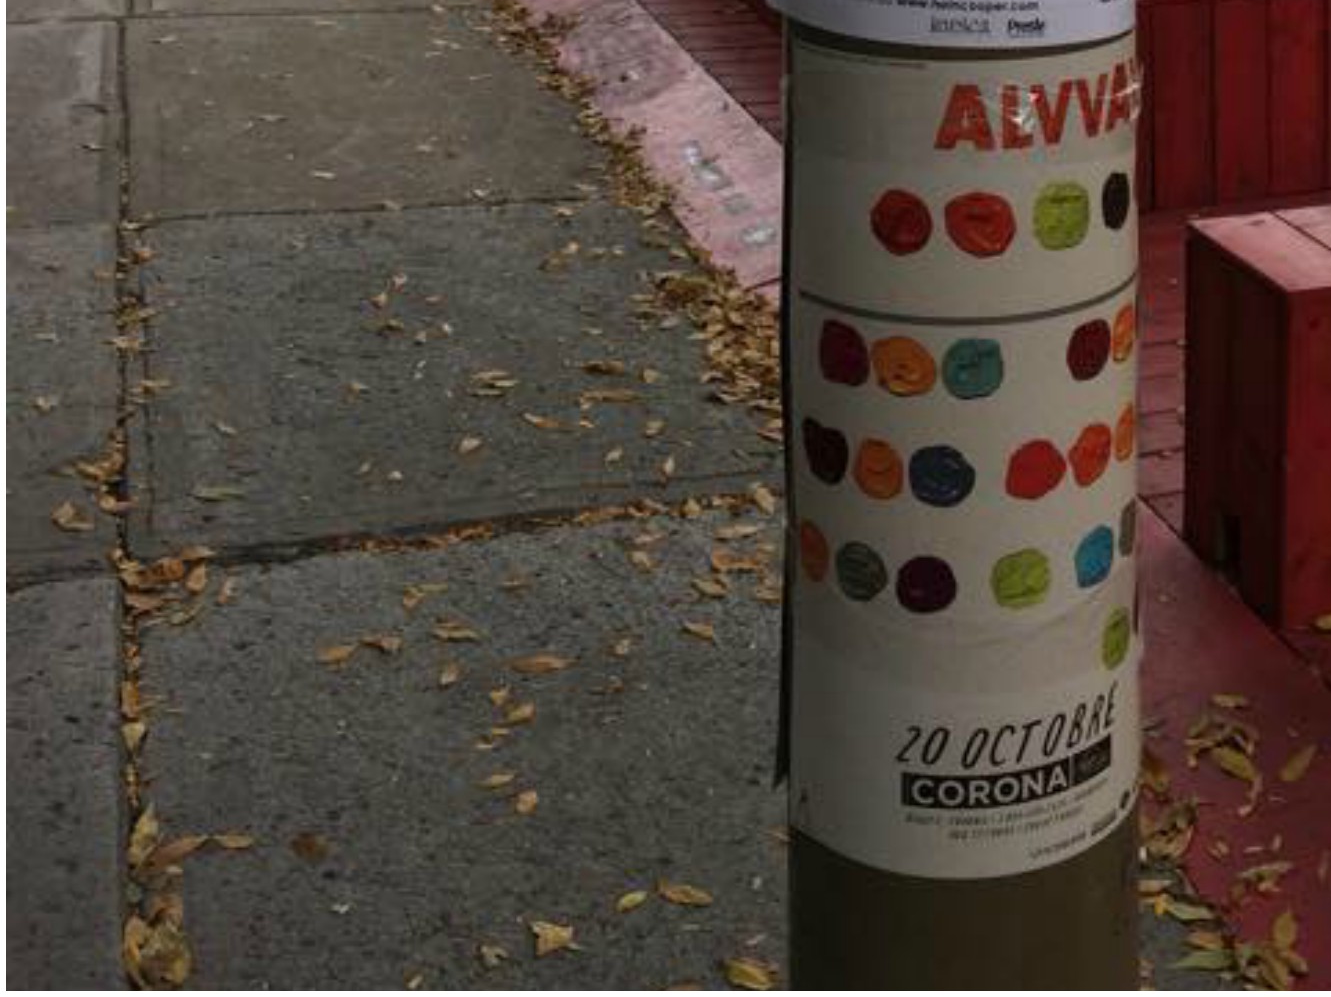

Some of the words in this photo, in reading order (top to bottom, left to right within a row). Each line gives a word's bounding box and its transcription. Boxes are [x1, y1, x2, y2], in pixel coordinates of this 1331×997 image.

[896, 725, 951, 766] 20
[961, 680, 1118, 769] OCTOBRE
[911, 765, 1068, 806] CORONA
